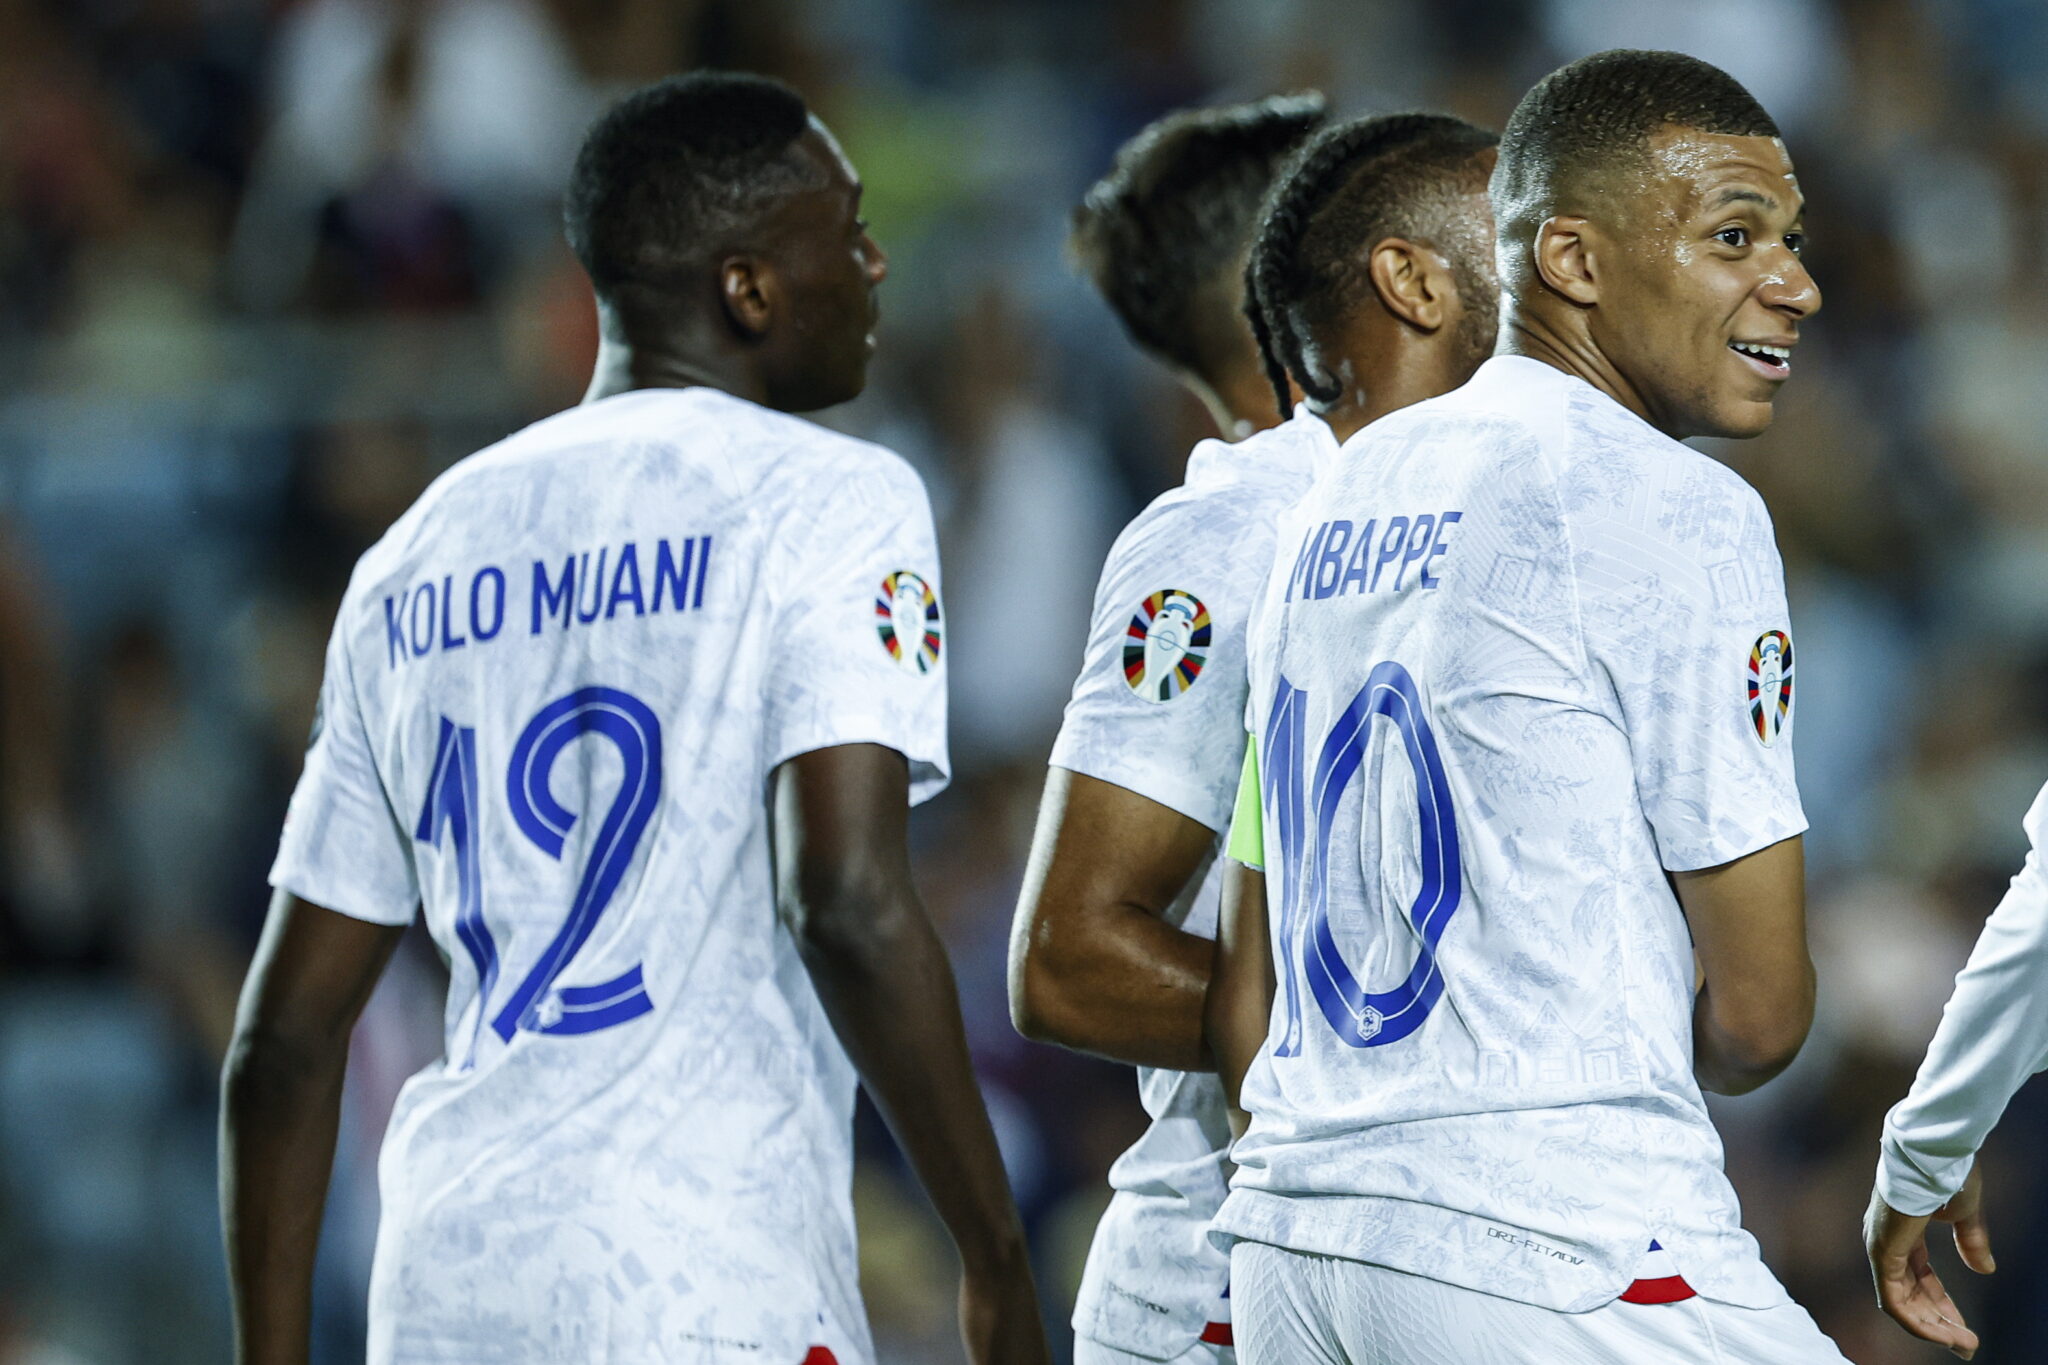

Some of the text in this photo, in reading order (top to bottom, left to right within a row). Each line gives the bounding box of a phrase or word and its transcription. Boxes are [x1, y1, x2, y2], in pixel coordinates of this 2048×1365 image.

[384, 534, 712, 671] KOLO MUANI
[1285, 511, 1463, 603] MBAPPE
[416, 686, 663, 1072] 12
[1263, 660, 1461, 1058] 10
